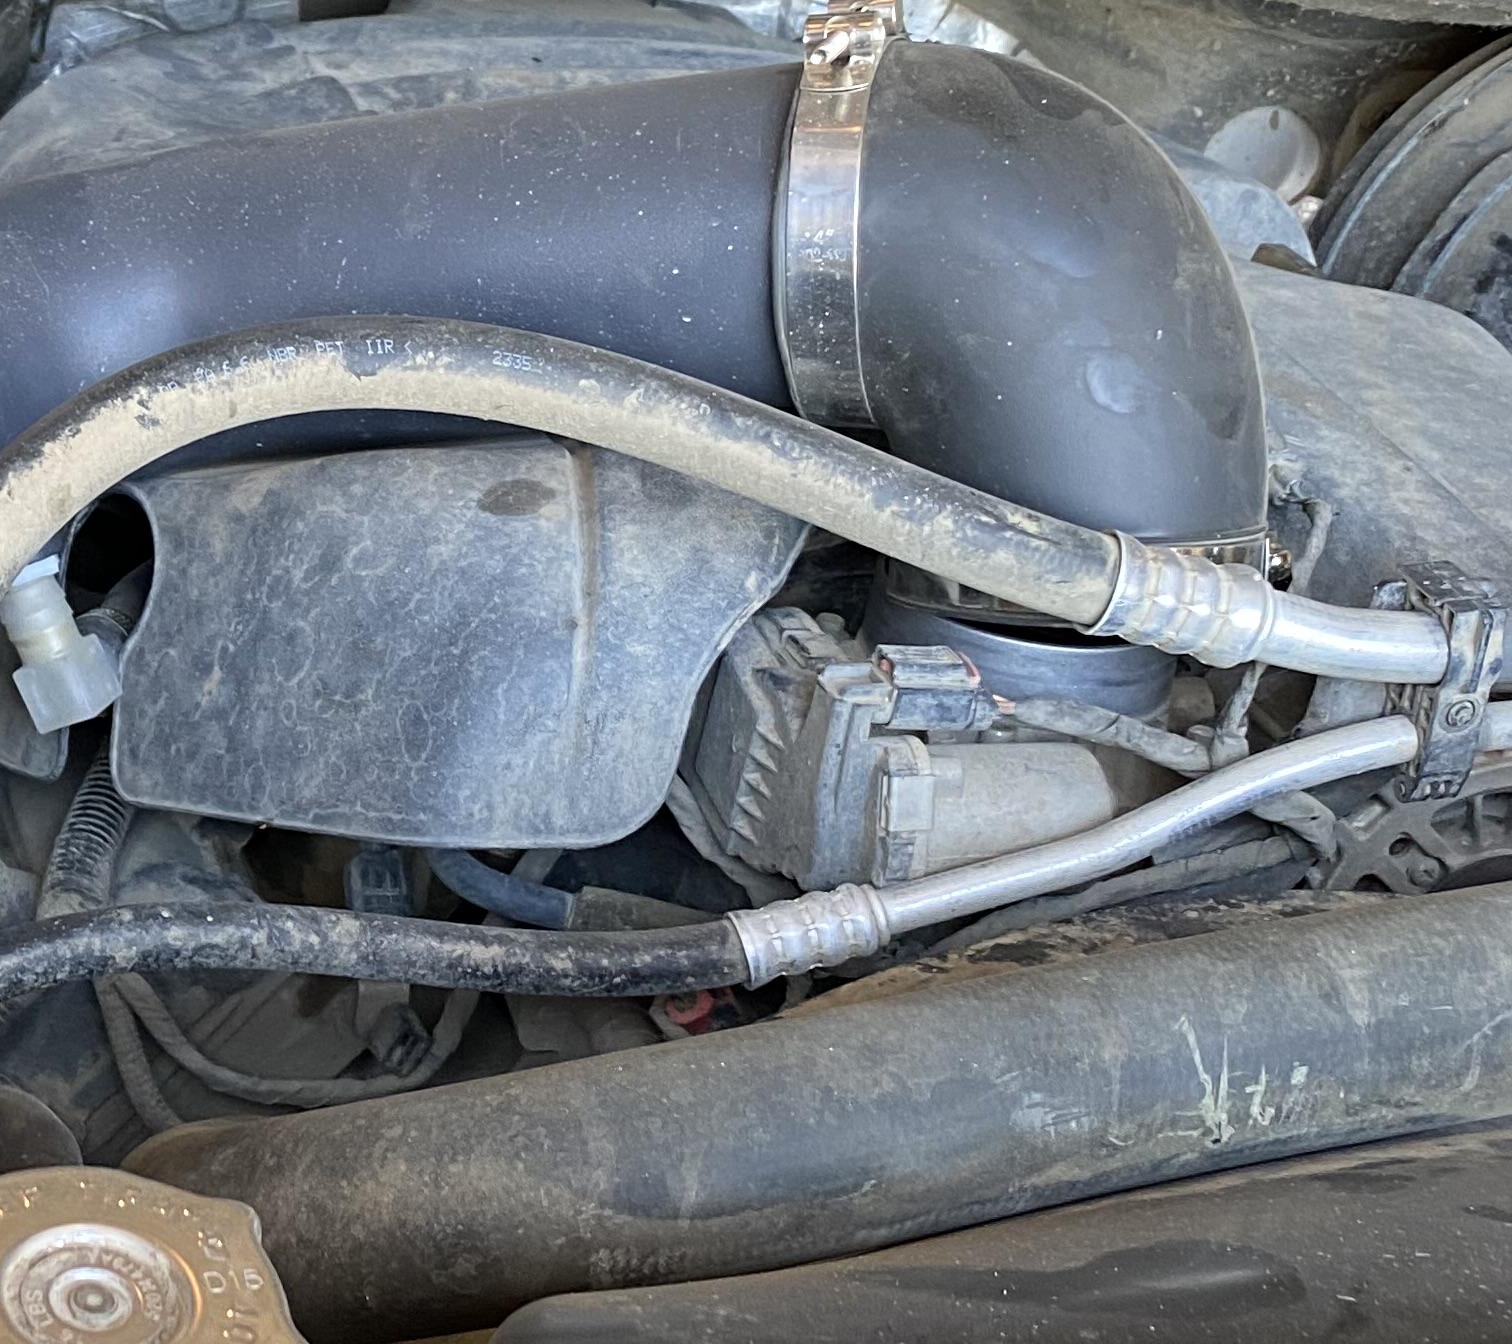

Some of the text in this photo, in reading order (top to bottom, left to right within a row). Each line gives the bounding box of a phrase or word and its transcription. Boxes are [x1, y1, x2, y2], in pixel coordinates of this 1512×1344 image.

[266, 345, 298, 364] NBR
[365, 338, 396, 356] IIR
[491, 350, 533, 371] 2335
